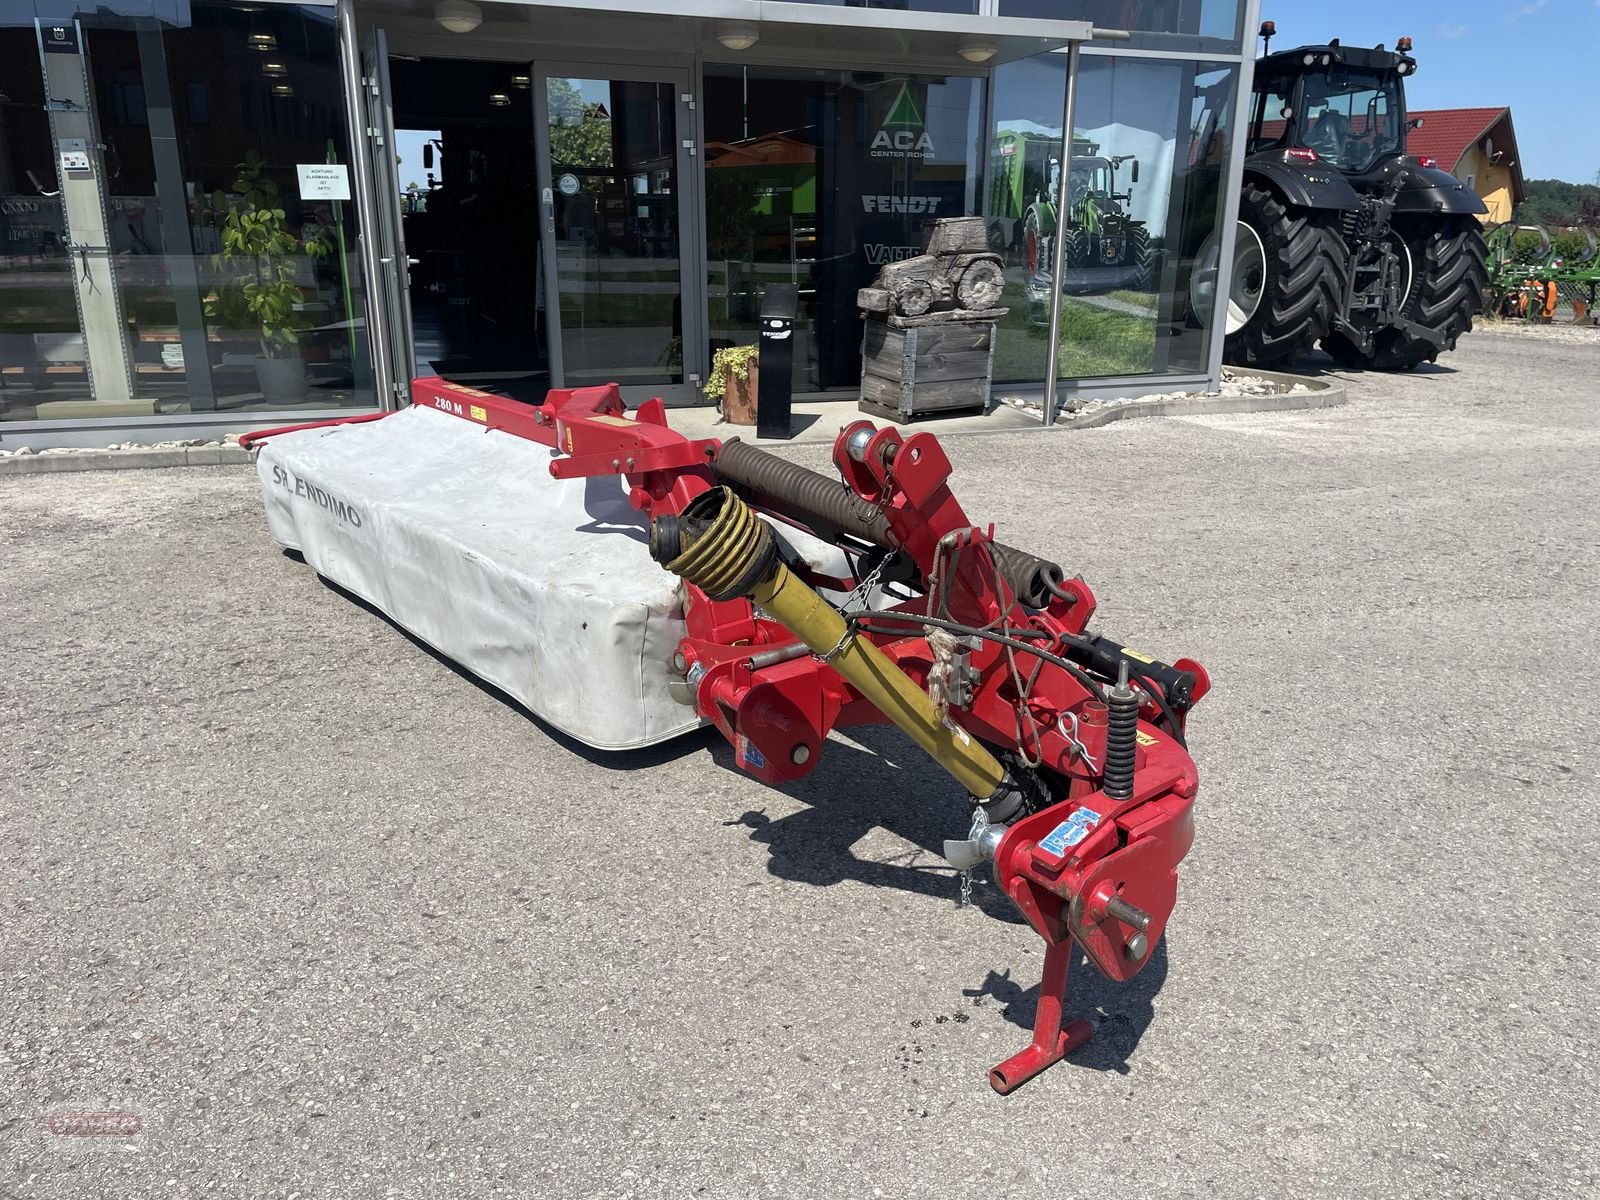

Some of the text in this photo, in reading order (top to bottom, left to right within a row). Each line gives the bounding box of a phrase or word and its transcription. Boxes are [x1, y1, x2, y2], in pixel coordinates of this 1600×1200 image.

[870, 130, 935, 151] ACA
[861, 194, 942, 214] FENDT
[434, 396, 452, 411] 280
[453, 402, 463, 415] M
